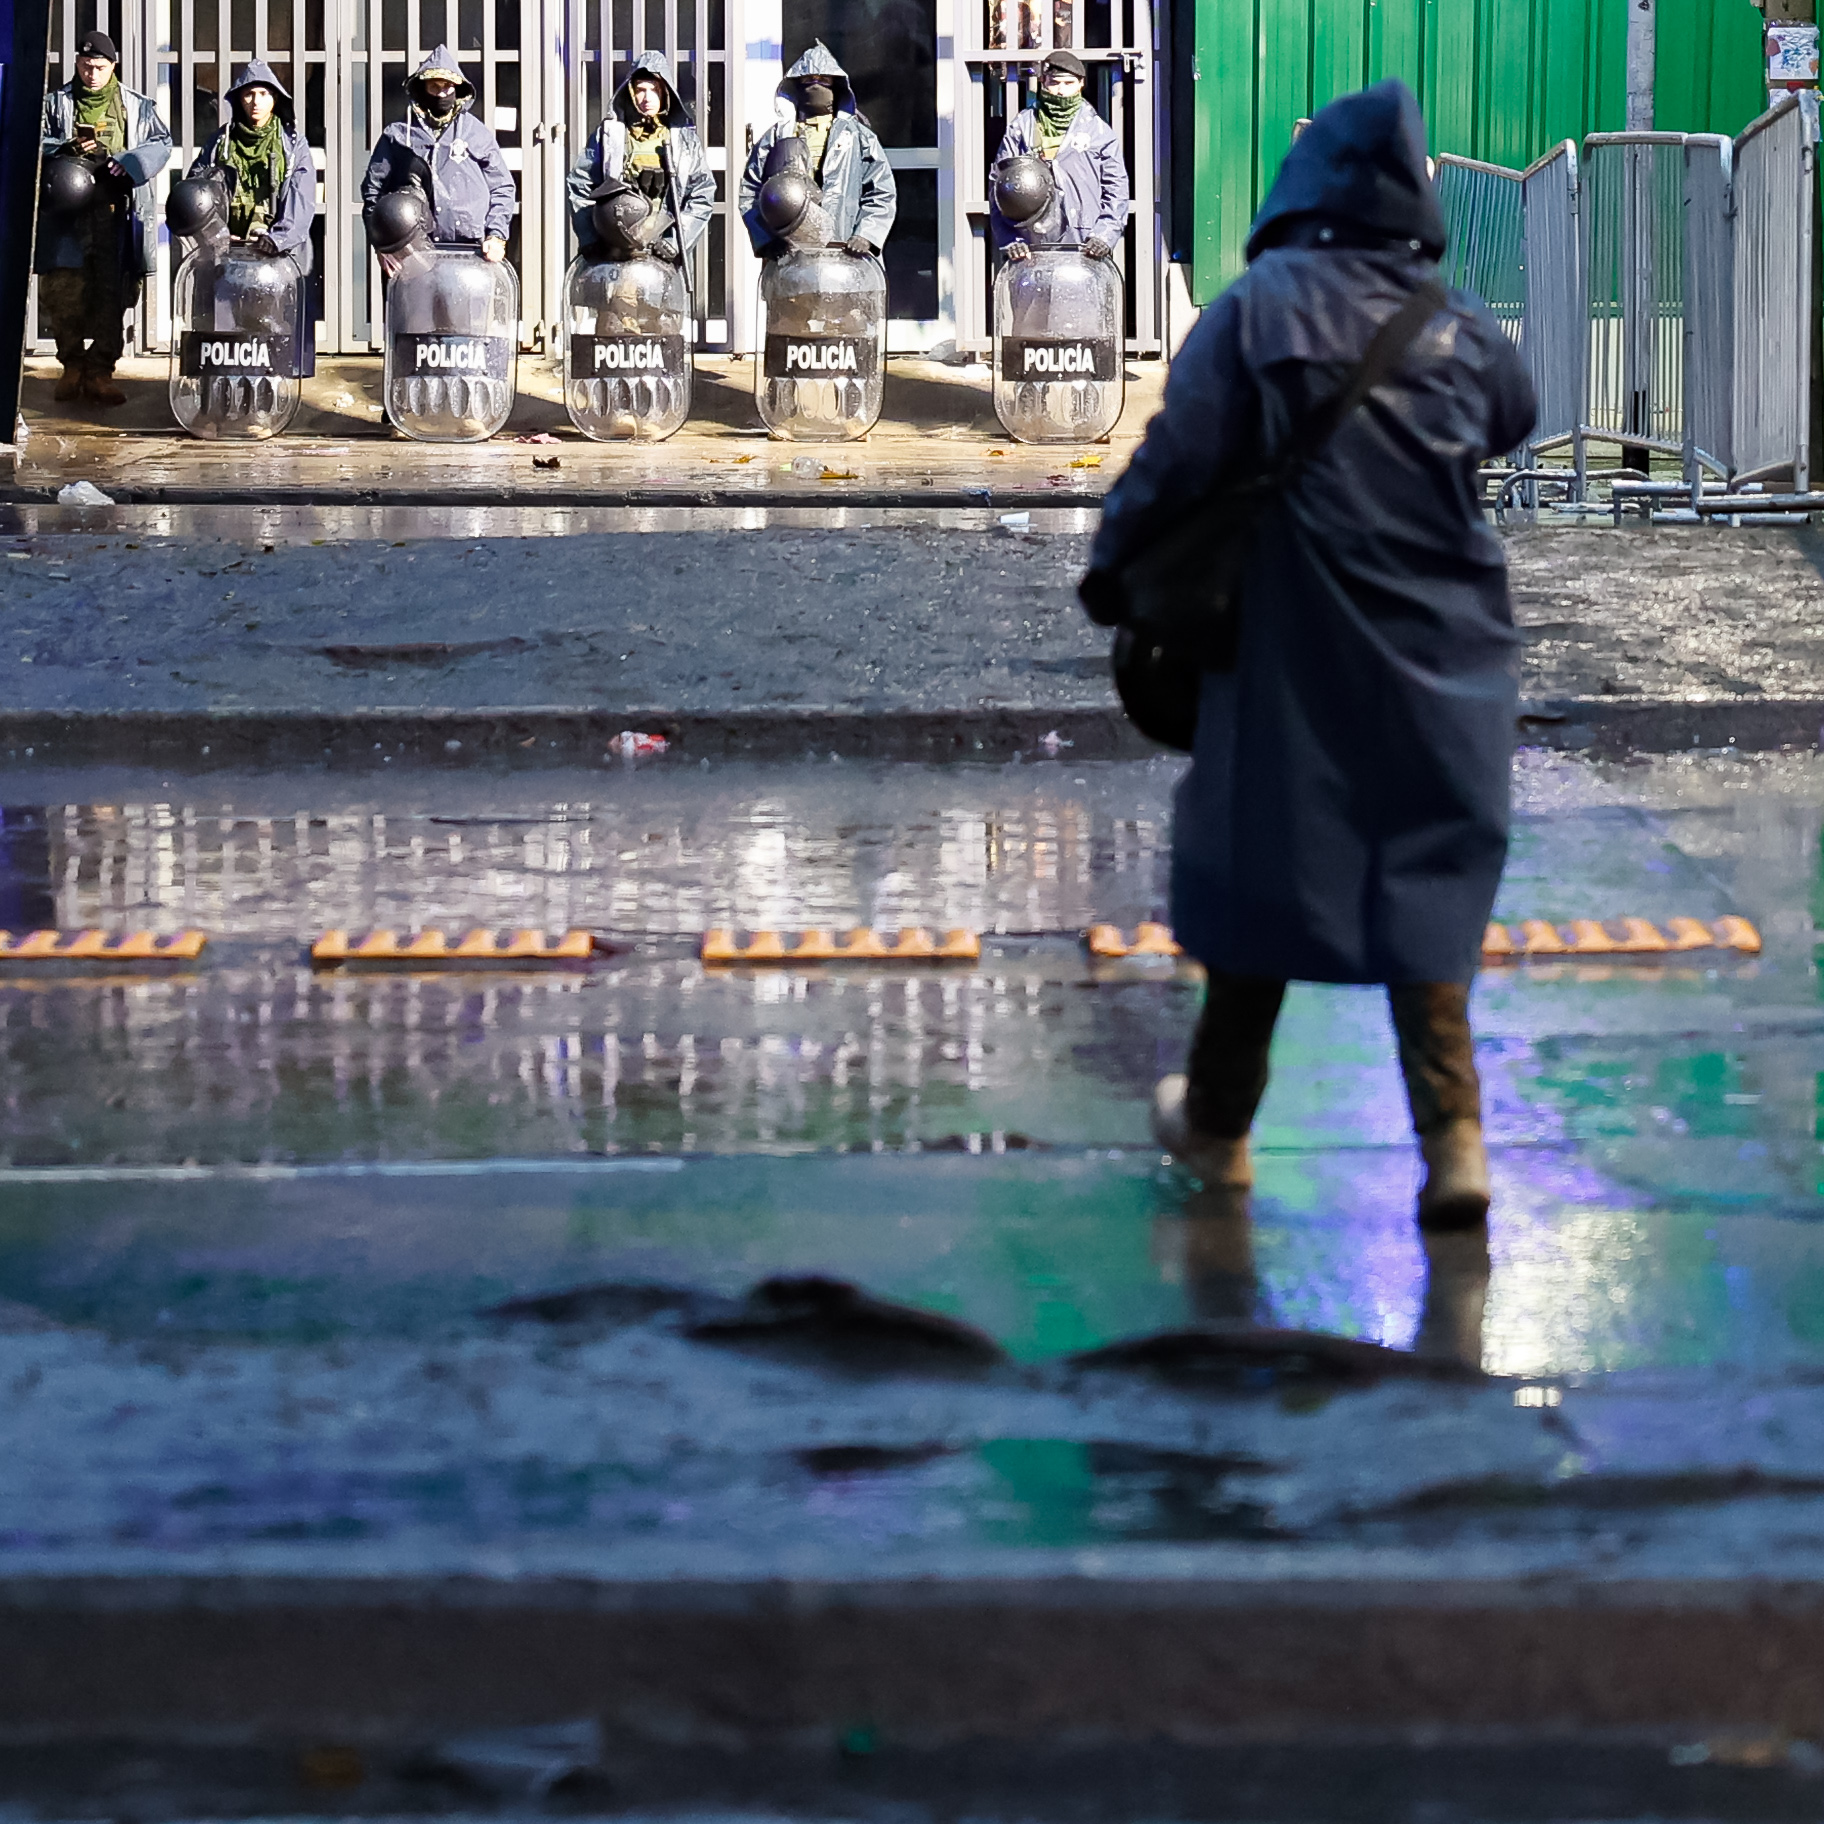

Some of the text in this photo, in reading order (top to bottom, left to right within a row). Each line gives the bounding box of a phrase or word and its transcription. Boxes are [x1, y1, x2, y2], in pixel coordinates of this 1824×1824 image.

[200, 337, 271, 367] POLICÍA
[416, 340, 487, 369] POLICÍA
[594, 339, 665, 369] POLICÍA
[786, 340, 858, 370] POLICÍA
[1024, 343, 1095, 373] POLICÍA
